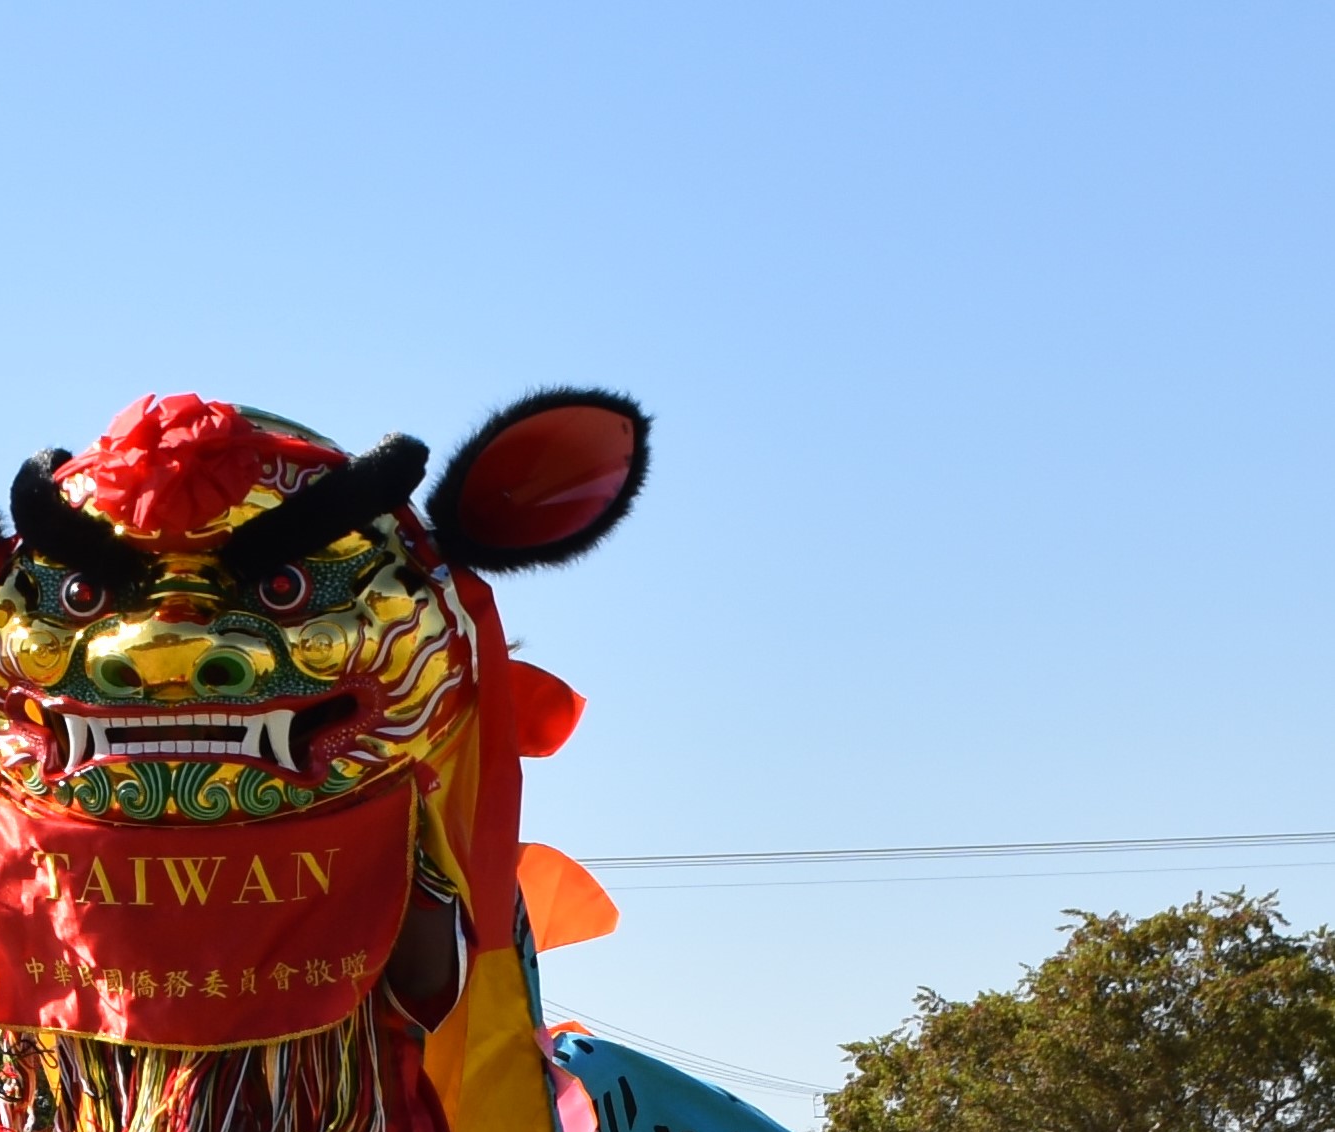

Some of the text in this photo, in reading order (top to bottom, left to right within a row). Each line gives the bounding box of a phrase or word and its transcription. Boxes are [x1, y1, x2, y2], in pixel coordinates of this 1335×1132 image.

[31, 848, 341, 906] TAIWAN
[25, 949, 368, 1000] 中華民國僑務委員會敬贈
